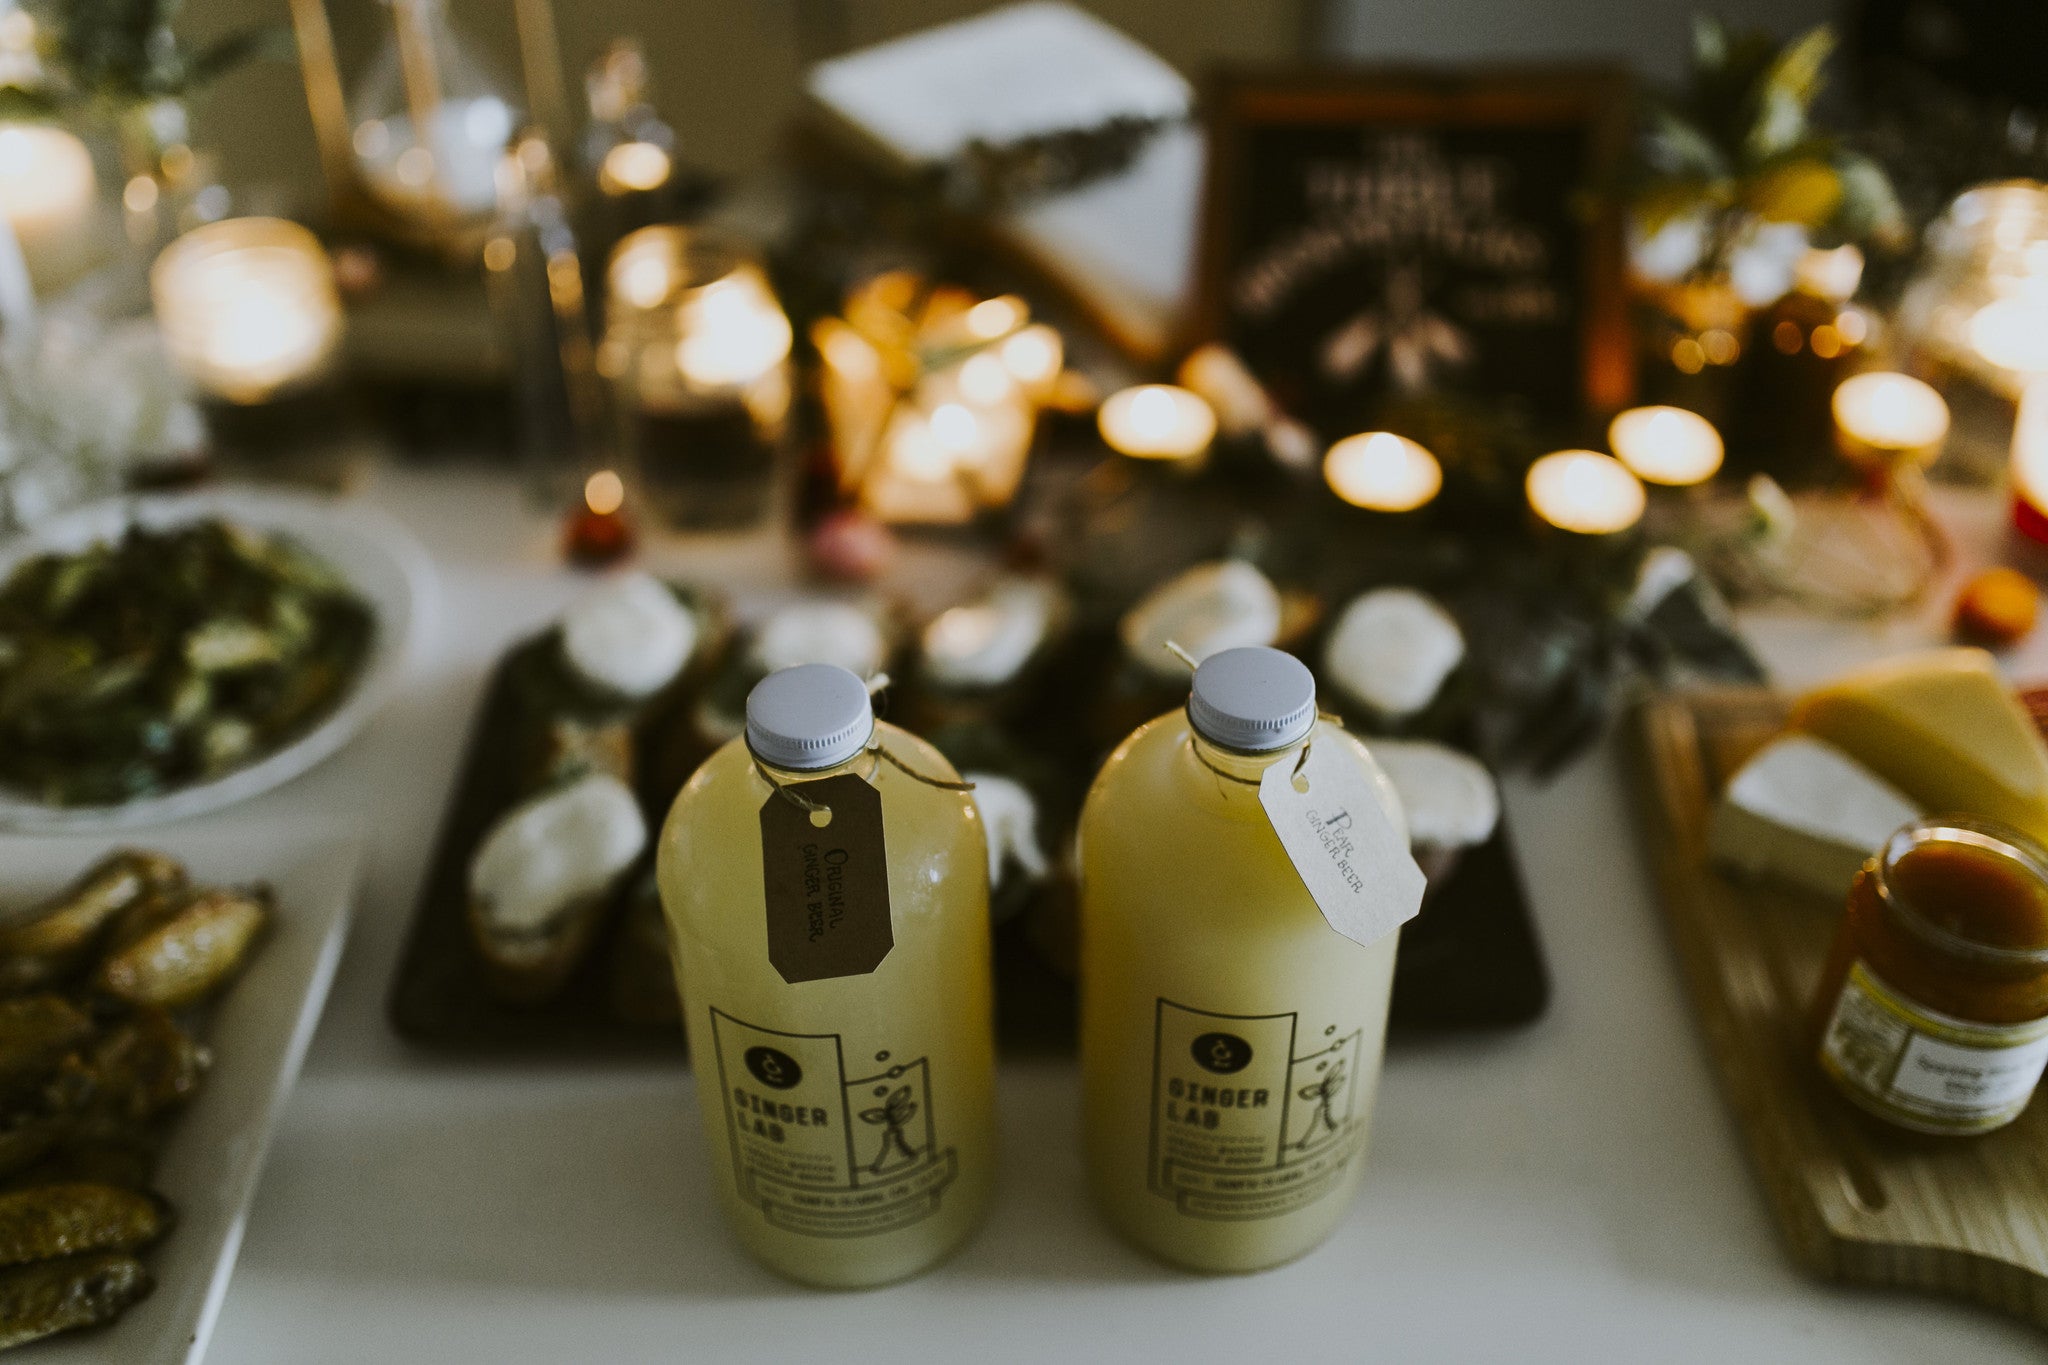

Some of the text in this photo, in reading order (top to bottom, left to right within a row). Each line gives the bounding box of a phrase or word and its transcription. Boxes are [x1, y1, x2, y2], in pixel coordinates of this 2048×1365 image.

[1305, 809, 1364, 894] GINGER BEER
[1326, 806, 1354, 858] PEAR
[802, 844, 824, 943] GINGER BEER
[823, 848, 849, 930] ORIGINAL
[733, 1087, 829, 1127] GINGER
[1167, 1101, 1221, 1131] LAB
[1168, 1077, 1270, 1109] GINGER
[736, 1109, 786, 1144] LAB
